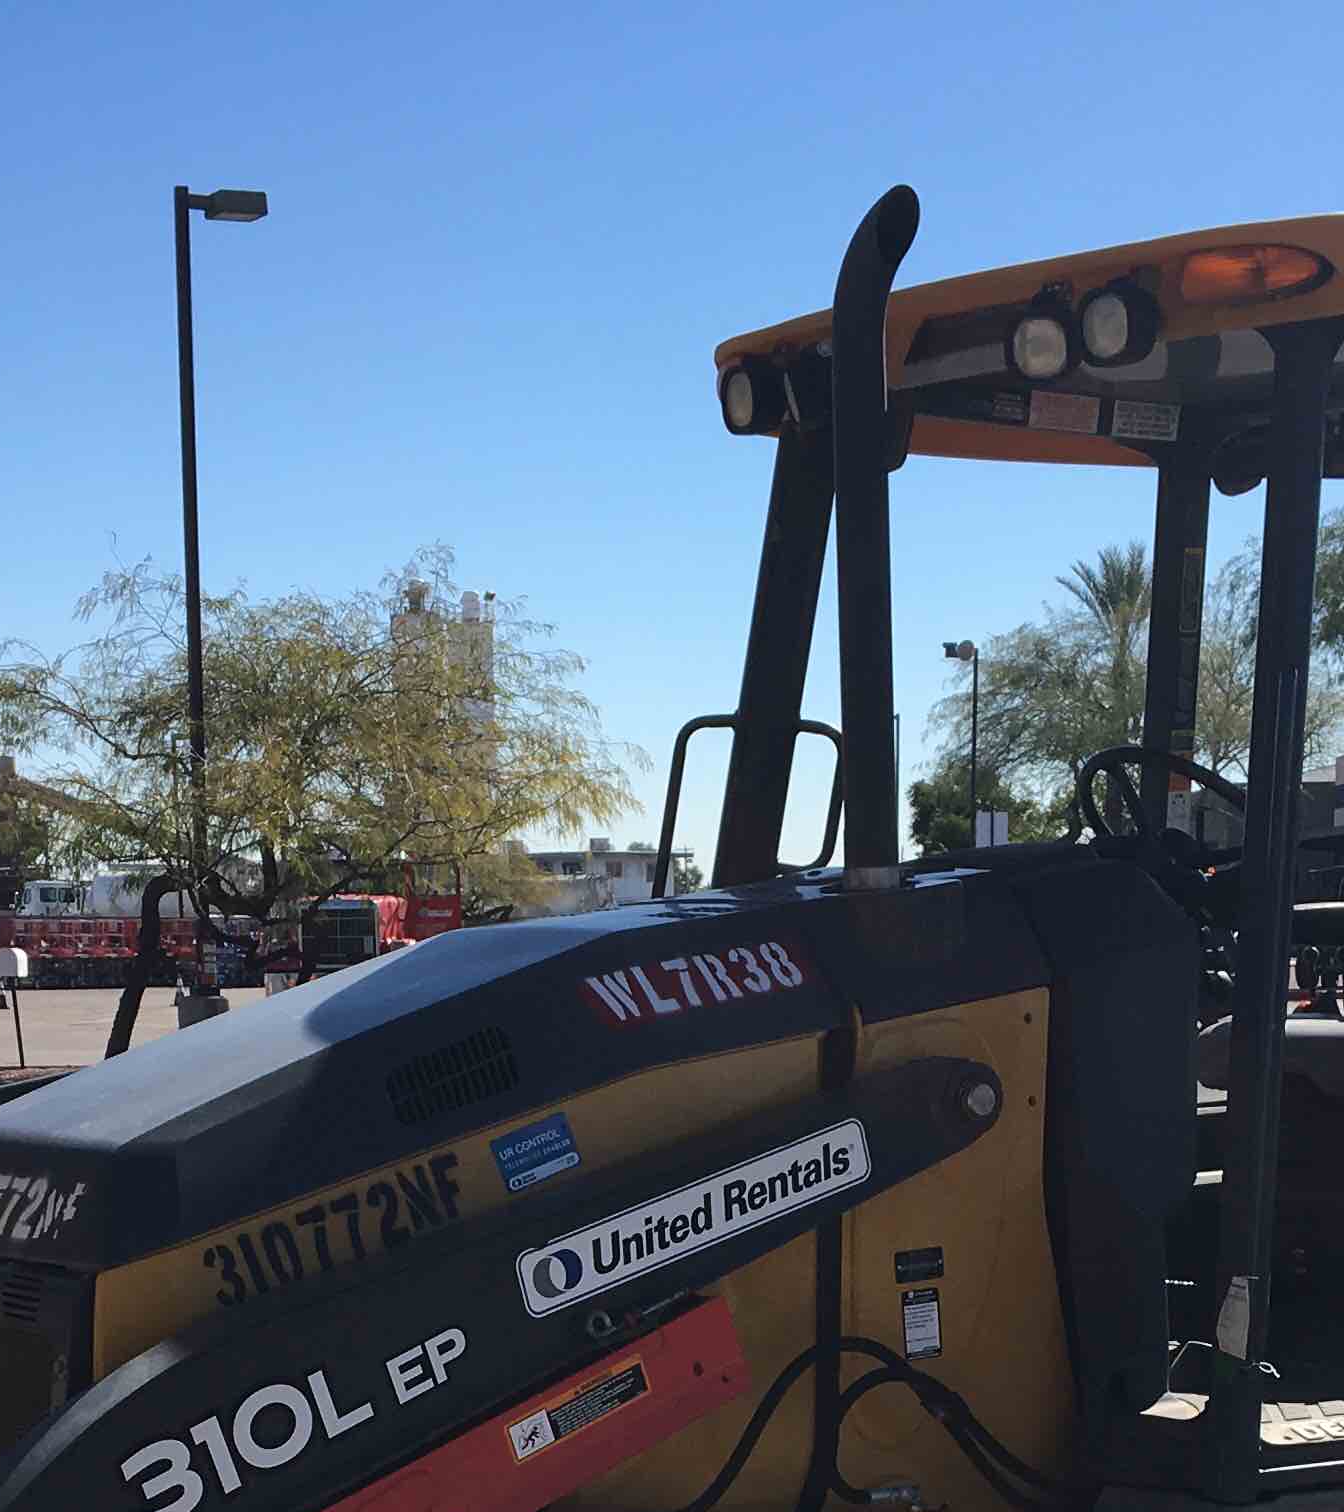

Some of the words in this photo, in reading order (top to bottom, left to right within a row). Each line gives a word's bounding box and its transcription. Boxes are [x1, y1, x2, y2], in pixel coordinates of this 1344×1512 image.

[585, 942, 803, 1021] WL7R38
[515, 1129, 560, 1154] CONTROL
[591, 1193, 713, 1275] United
[723, 1142, 851, 1222] Rentals
[385, 1328, 467, 1404] EP
